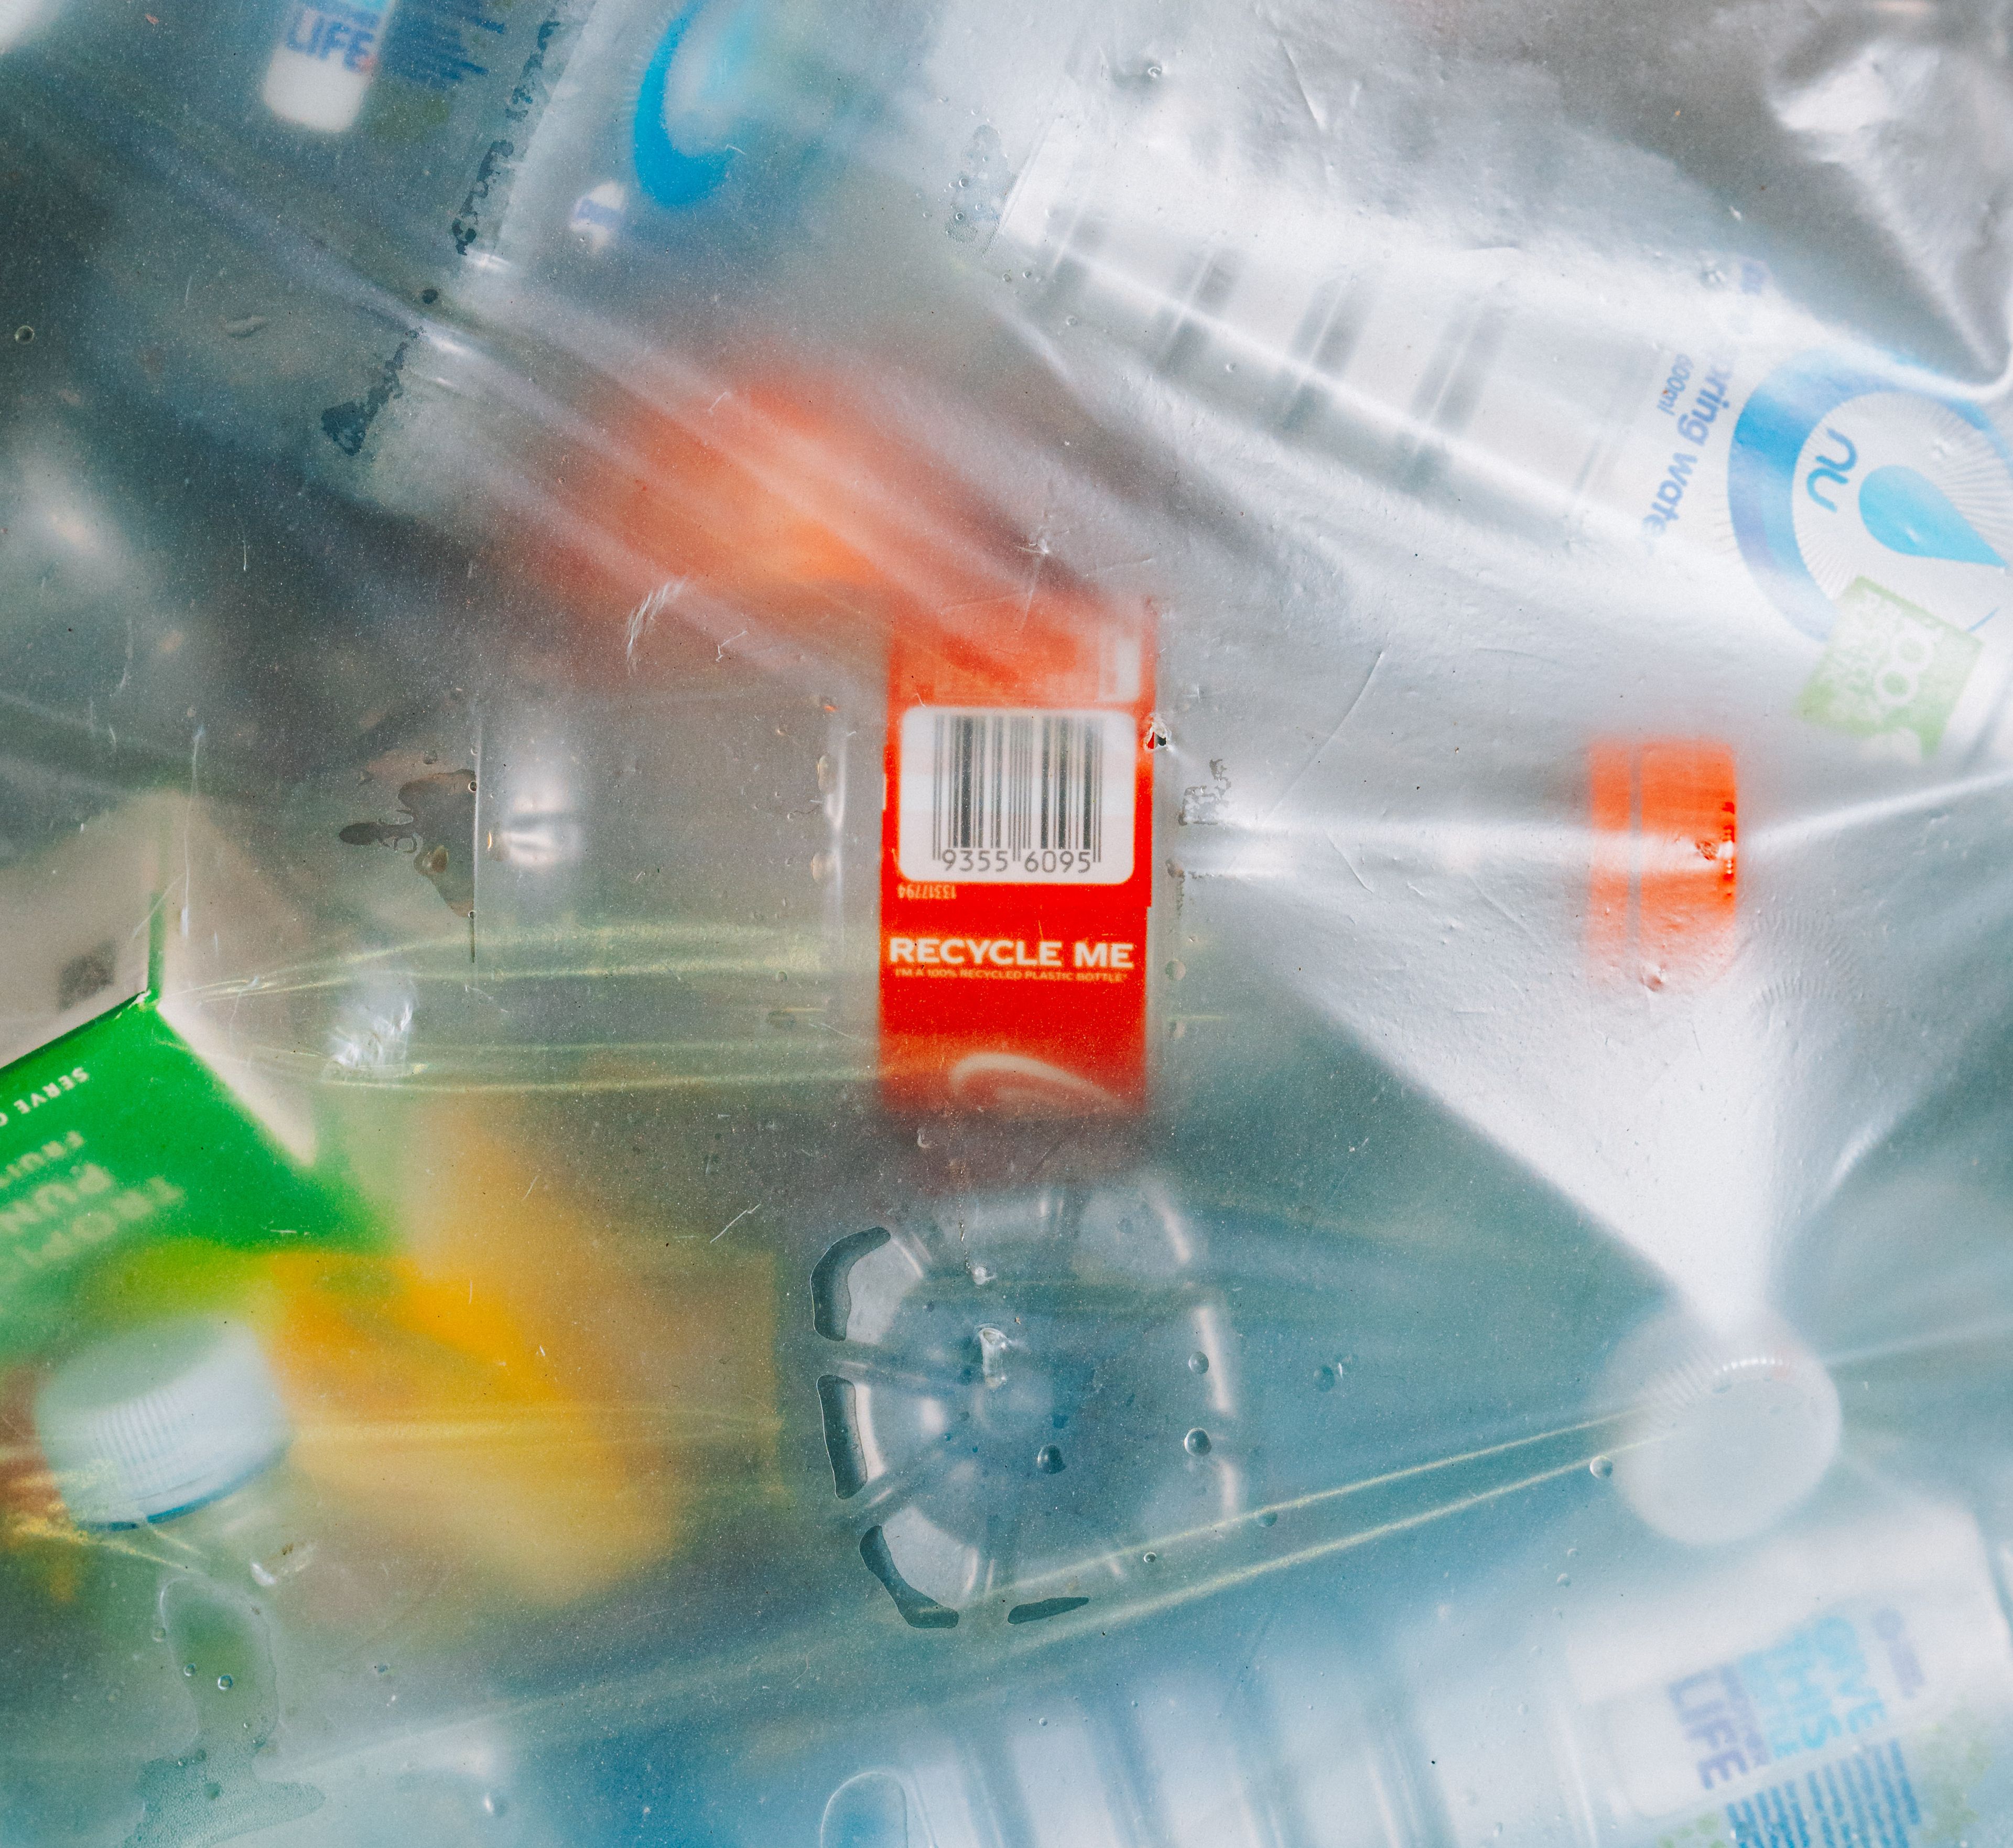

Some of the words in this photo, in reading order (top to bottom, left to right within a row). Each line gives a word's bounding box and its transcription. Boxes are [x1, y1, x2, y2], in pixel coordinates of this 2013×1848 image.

[286, 8, 374, 74] LIFE
[1657, 353, 1694, 416] 600ml
[1806, 427, 1857, 513] nu
[890, 938, 1062, 966] RECYCLE
[1075, 943, 1134, 968] ME
[960, 970, 1022, 980] RECYCLED
[1025, 971, 1074, 981] PLASTIC
[14, 1066, 90, 1114] SERVE
[1666, 1667, 1749, 1790] LIFE
